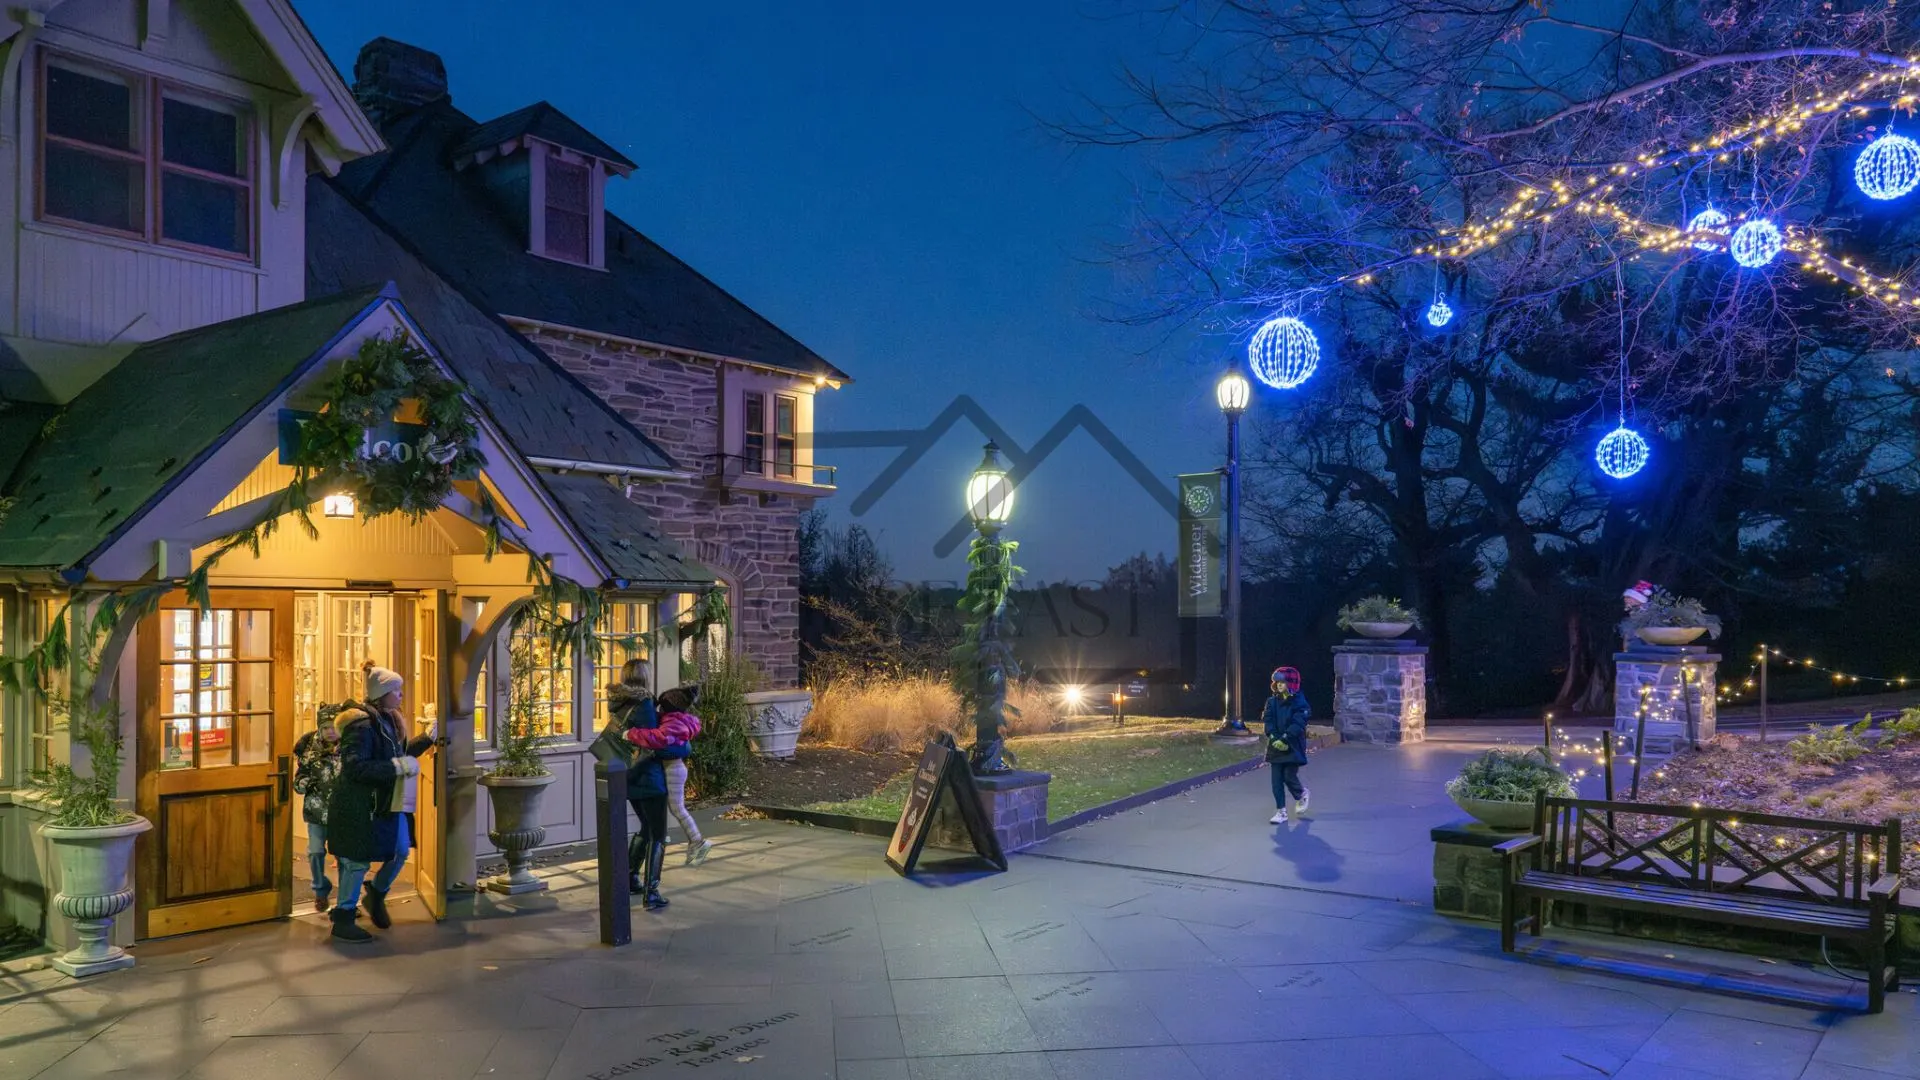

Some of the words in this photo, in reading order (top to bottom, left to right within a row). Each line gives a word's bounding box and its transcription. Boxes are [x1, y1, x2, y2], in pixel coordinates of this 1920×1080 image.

[1188, 524, 1202, 597] Widener
[646, 1028, 700, 1043] The
[729, 1009, 800, 1035] Dixon
[676, 1035, 771, 1068] Terrace
